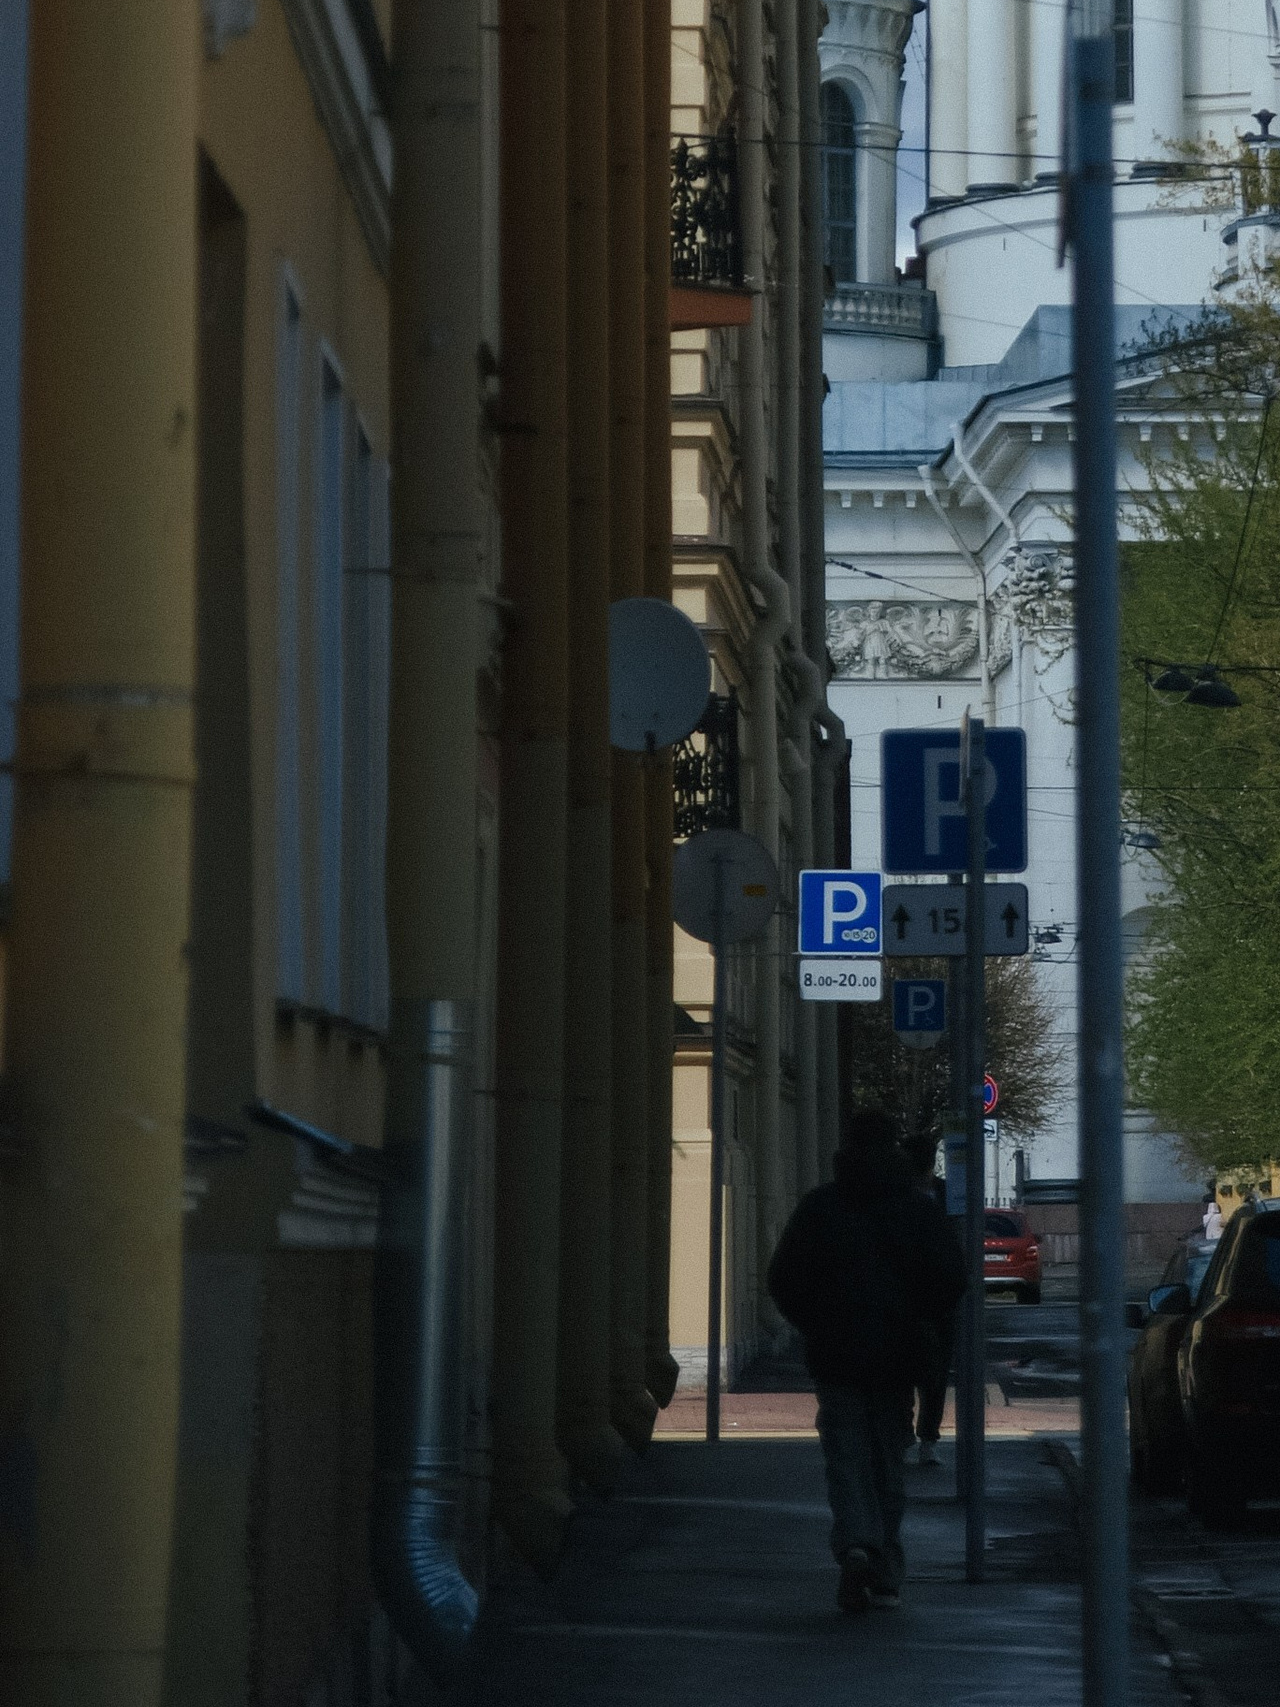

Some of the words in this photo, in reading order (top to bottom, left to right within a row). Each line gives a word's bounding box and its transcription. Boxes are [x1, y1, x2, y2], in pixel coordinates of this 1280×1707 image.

[823, 881, 867, 944] P
[863, 930, 876, 940] 20
[804, 973, 877, 987] 8.00-20.00
[908, 986, 935, 1025] P
